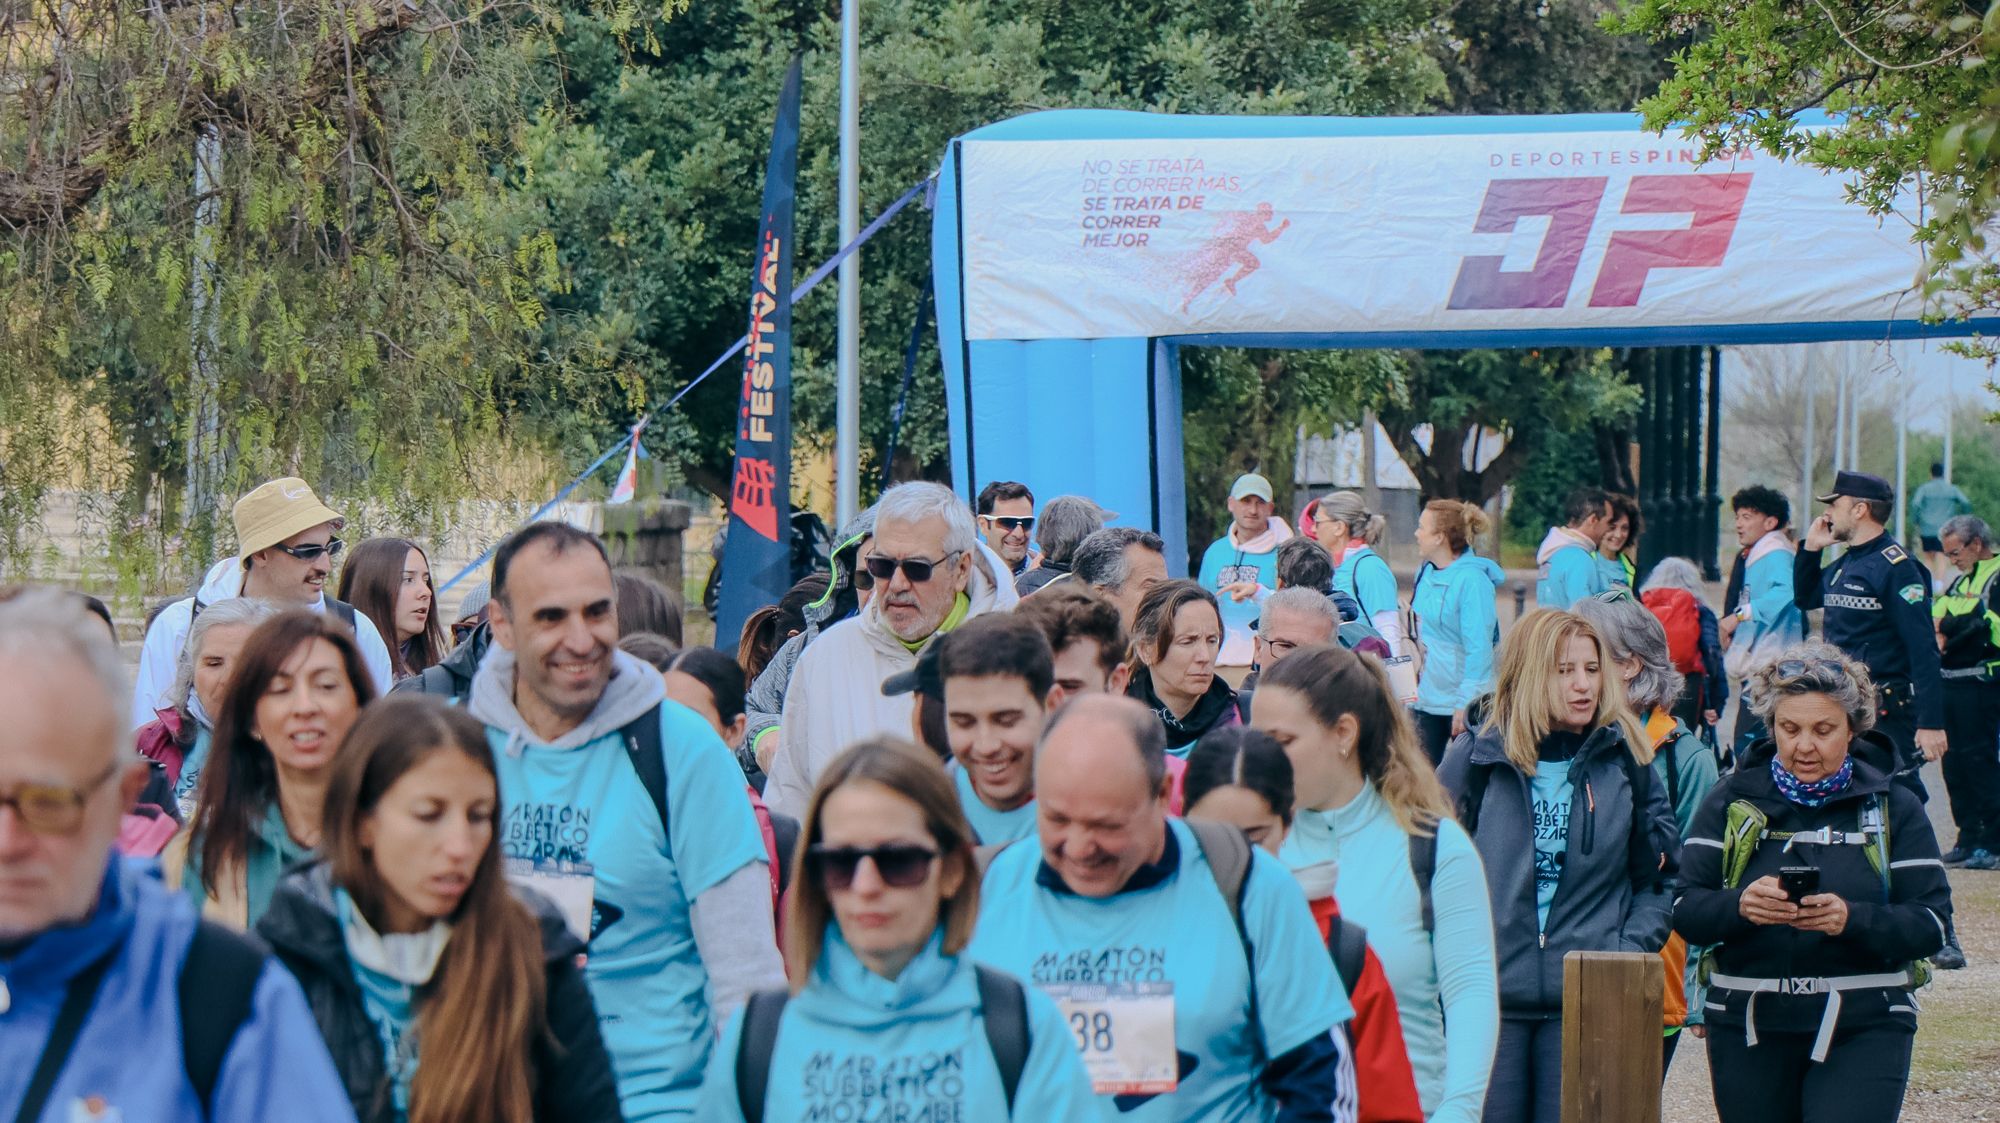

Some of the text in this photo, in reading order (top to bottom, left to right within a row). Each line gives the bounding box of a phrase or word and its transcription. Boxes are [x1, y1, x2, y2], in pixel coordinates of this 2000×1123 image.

[1489, 147, 1756, 167] DEPORTESPINA
[1082, 158, 1205, 175] NO SE TRATA
[1082, 178, 1110, 193] DE
[1113, 177, 1193, 193] CORRER
[1083, 195, 1206, 211] SE TRATA DE
[1082, 215, 1161, 229] CORRER
[1082, 233, 1149, 247] MEJOR
[749, 238, 780, 443] FESTIVAL
[508, 801, 591, 826] ARATÓN
[1533, 799, 1568, 814] ARAT
[1534, 813, 1569, 827] BBÉT
[508, 820, 589, 845] BBÉTICO
